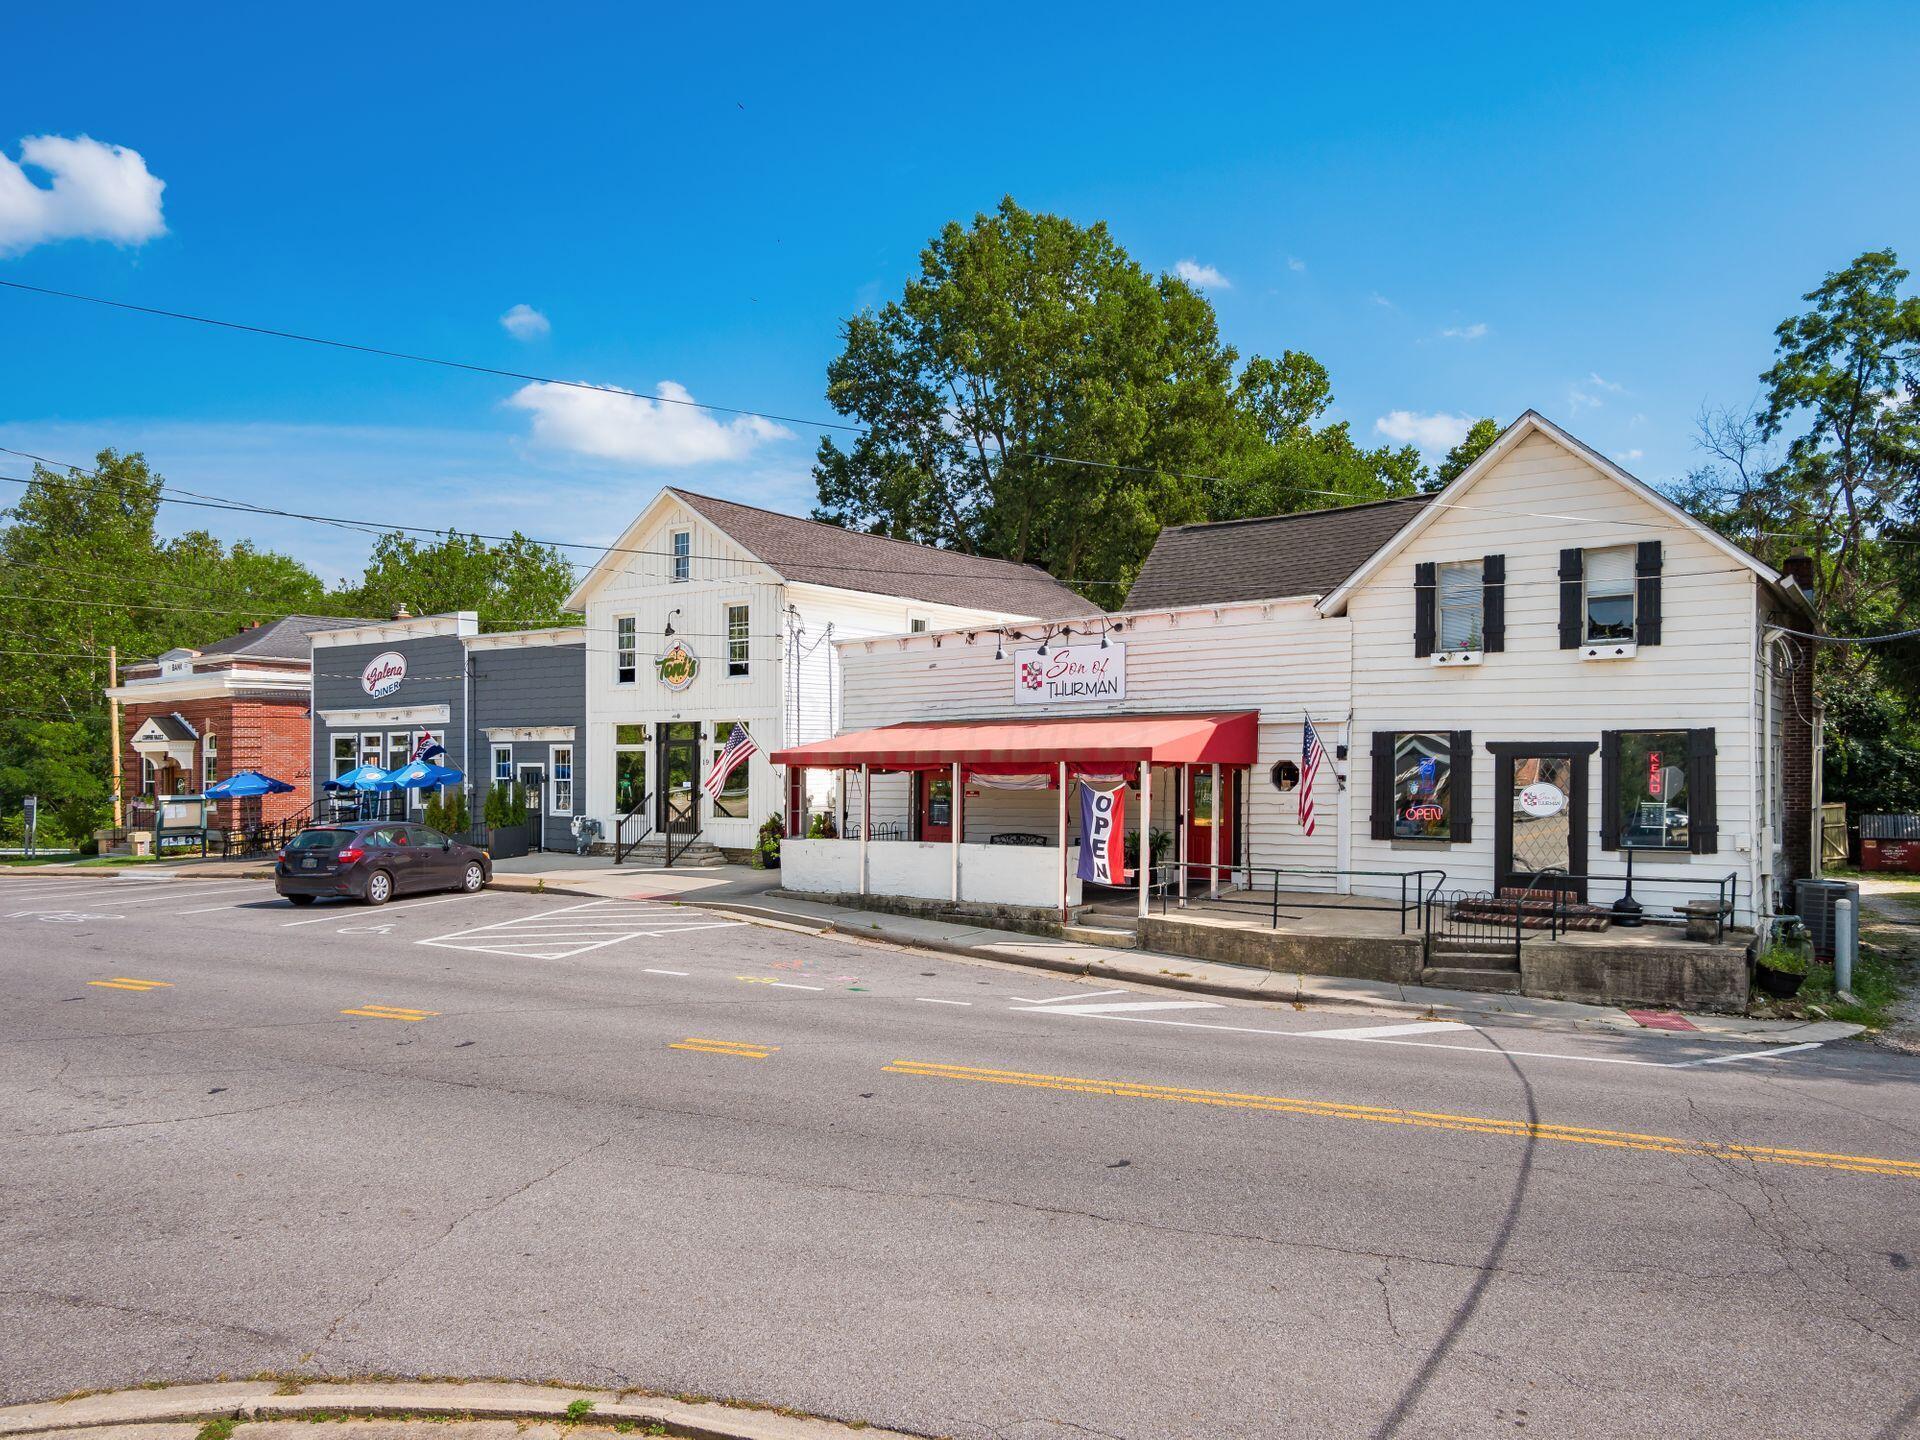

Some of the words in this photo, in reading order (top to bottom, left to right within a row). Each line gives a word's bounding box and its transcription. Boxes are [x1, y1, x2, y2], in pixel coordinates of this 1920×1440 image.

[171, 663, 183, 672] BANK
[366, 661, 403, 692] Galena
[1046, 650, 1087, 679] Son
[1092, 658, 1109, 682] of
[374, 681, 401, 698] DINER
[1046, 676, 1118, 699] THURMAN
[1650, 753, 1661, 794] KENO
[1405, 807, 1441, 821] OPEN
[1092, 795, 1112, 880] OPEN
